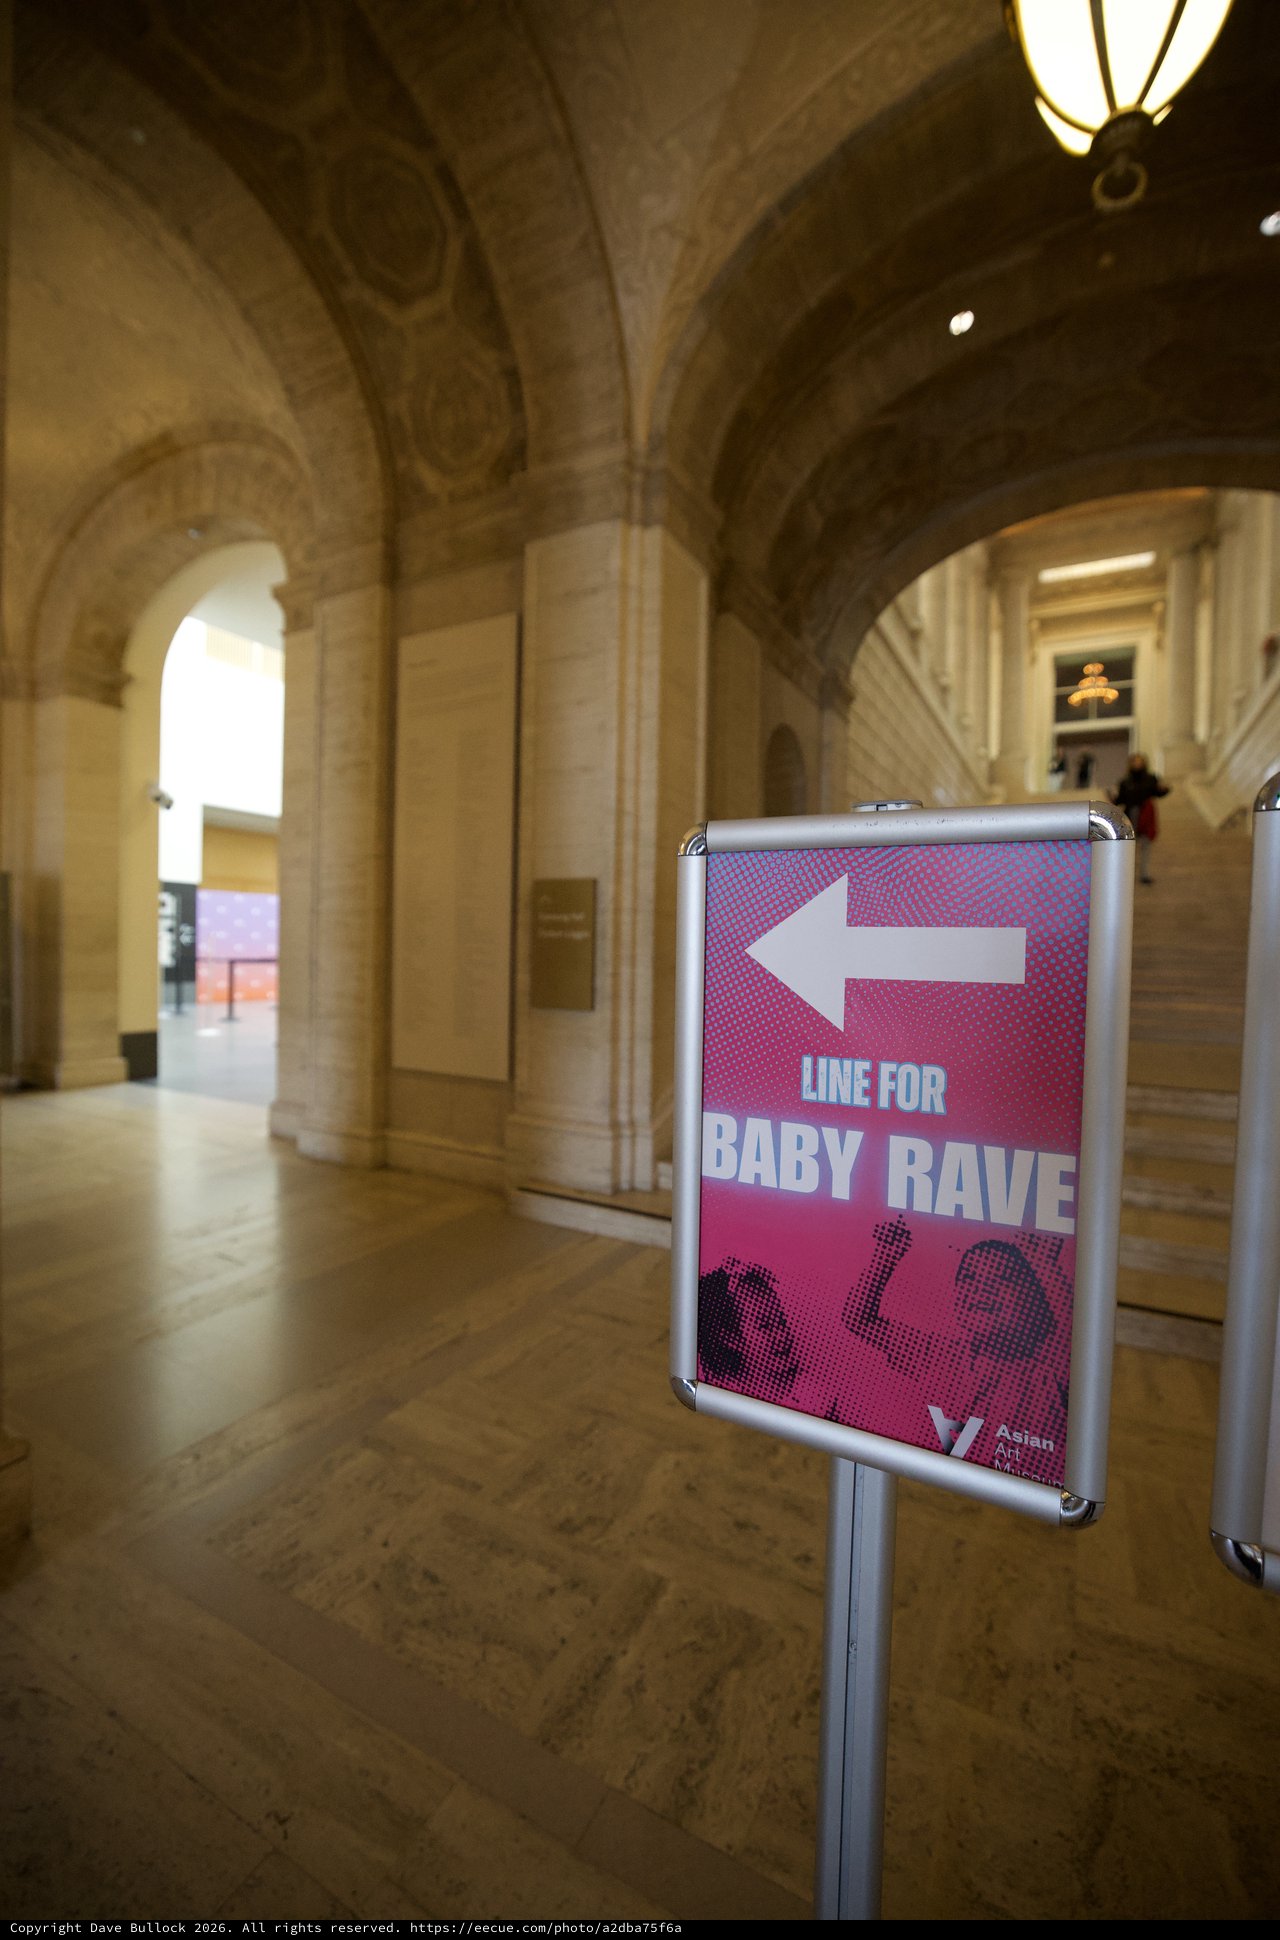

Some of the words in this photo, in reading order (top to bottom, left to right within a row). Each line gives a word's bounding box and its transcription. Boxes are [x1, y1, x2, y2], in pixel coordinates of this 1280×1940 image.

[802, 1055, 872, 1107] LINE
[878, 1061, 947, 1114] FOR
[702, 1111, 864, 1200] BABY
[887, 1135, 1077, 1235] RAVE
[994, 1442, 1021, 1462] Art
[996, 1423, 1055, 1452] Asian
